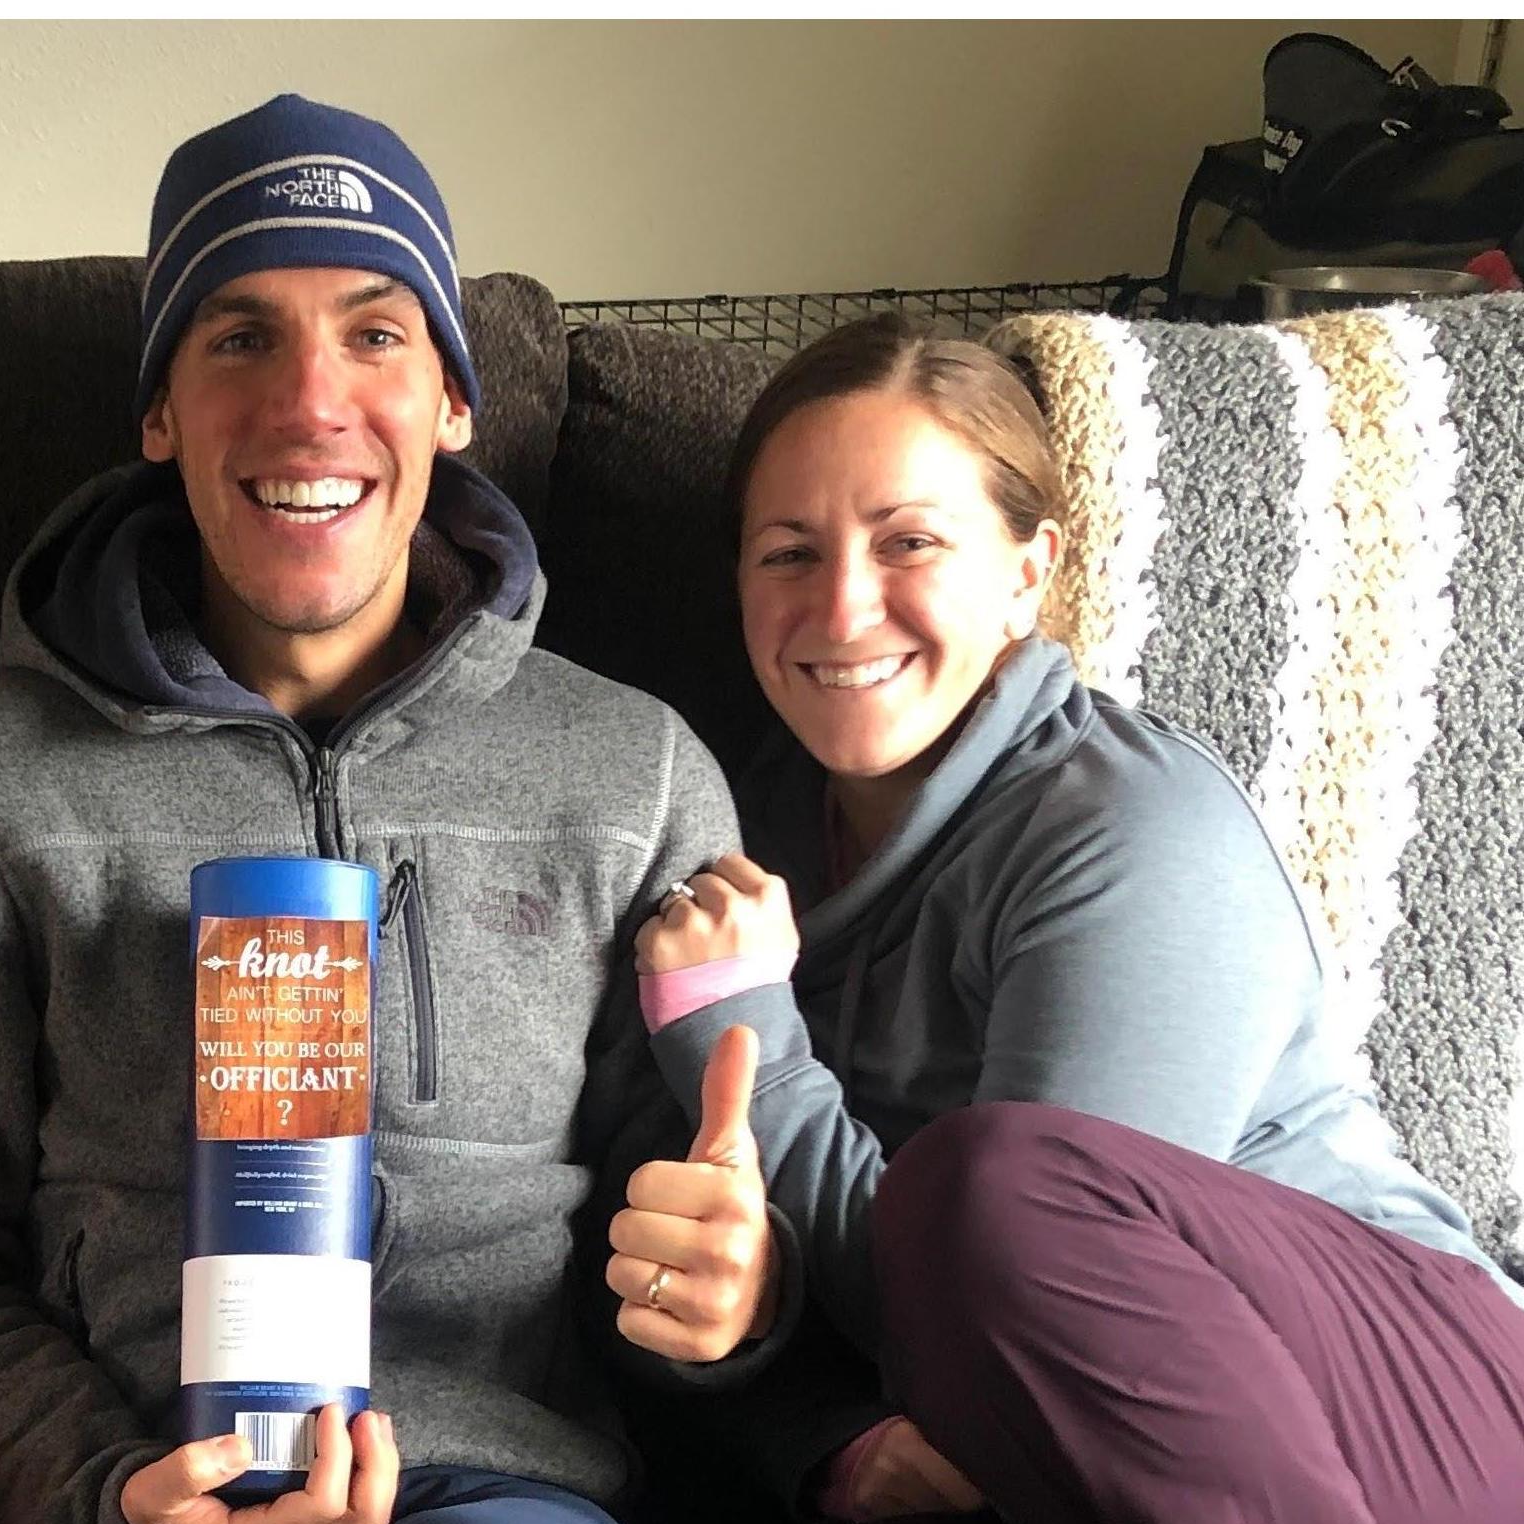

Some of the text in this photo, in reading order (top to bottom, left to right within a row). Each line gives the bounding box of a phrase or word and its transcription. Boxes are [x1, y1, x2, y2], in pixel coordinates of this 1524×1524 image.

[298, 167, 337, 181] THE
[264, 179, 341, 199] NORTH
[290, 192, 341, 209] FACE
[266, 929, 305, 946] THIS
[238, 937, 332, 980] knot
[227, 986, 344, 1003] AIN'T GETTIN'
[200, 1007, 367, 1025] TIED WITHOUT YOU
[199, 1041, 366, 1058] WILL YOU BE OUR
[210, 1066, 358, 1092] OFFICIANT
[276, 1099, 294, 1126] ?
